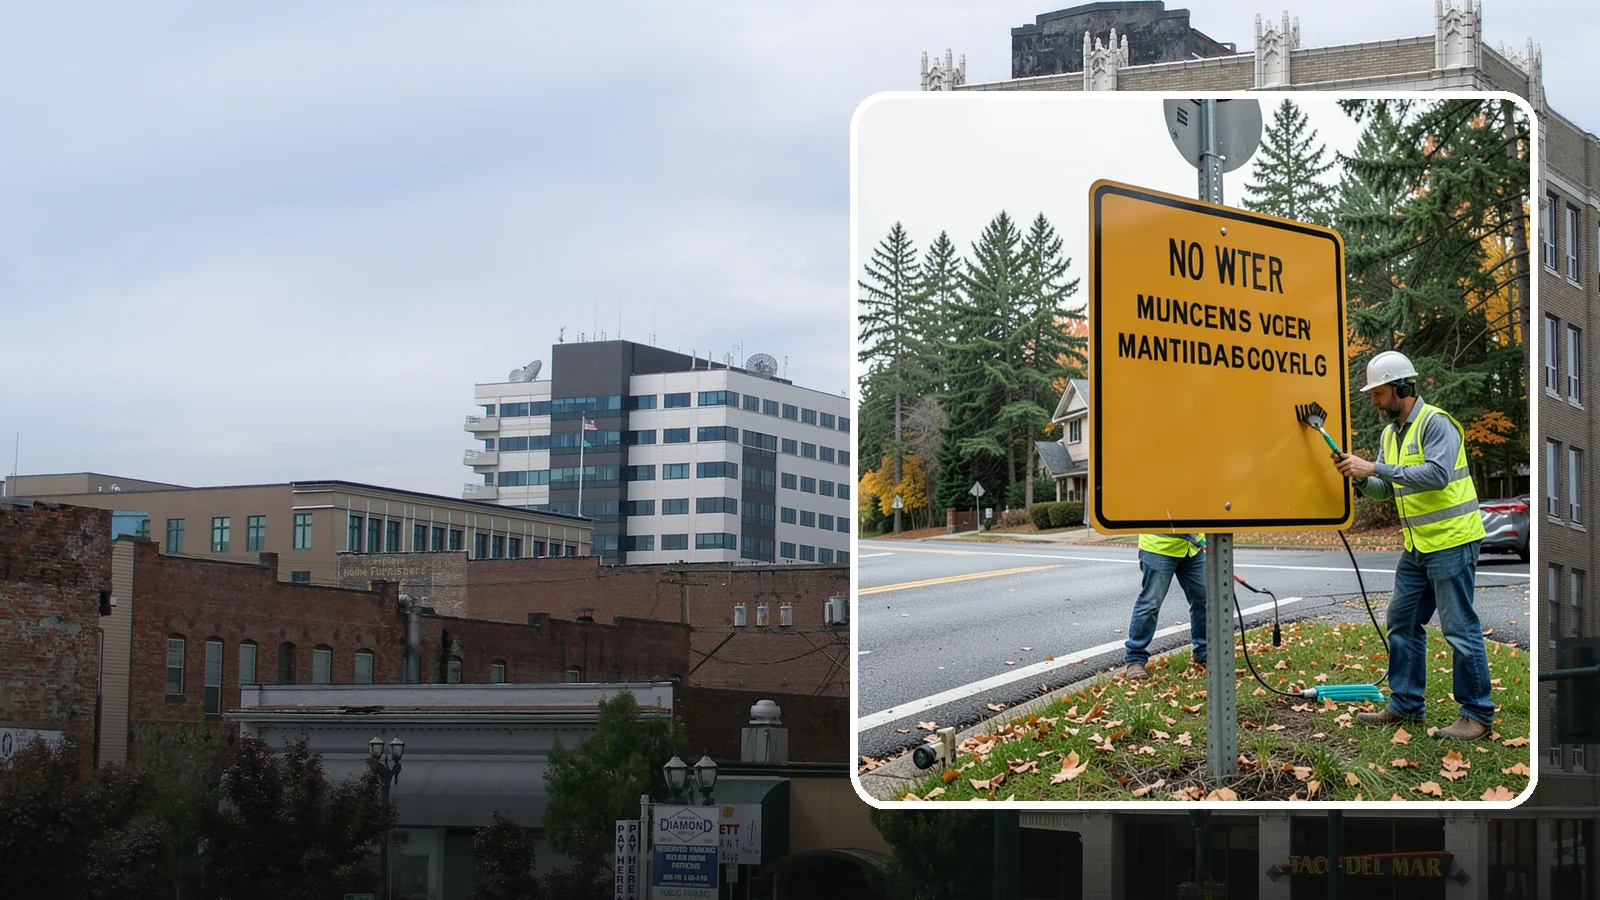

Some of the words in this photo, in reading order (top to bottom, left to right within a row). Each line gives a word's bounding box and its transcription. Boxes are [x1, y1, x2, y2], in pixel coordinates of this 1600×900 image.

[1169, 238, 1204, 281] NO
[1215, 245, 1284, 294] WTER
[1137, 294, 1252, 333] MUNCENS
[343, 568, 368, 577] Home
[370, 566, 427, 577] Furnishers
[660, 818, 713, 833] DIAMOND
[1022, 815, 1070, 828] BUILDING
[617, 825, 625, 852] PAY
[628, 825, 637, 852] PAY
[656, 845, 688, 853] RESERVED
[689, 846, 716, 854] PARKING
[616, 856, 625, 894] HERE
[627, 856, 636, 893] HERE
[671, 862, 701, 870] PATRONS
[1290, 855, 1330, 874] TAC
[1346, 857, 1384, 875] DEL
[1392, 858, 1442, 876] MAR
[660, 888, 682, 897] PUBLIC
[683, 889, 710, 898] PARKING
